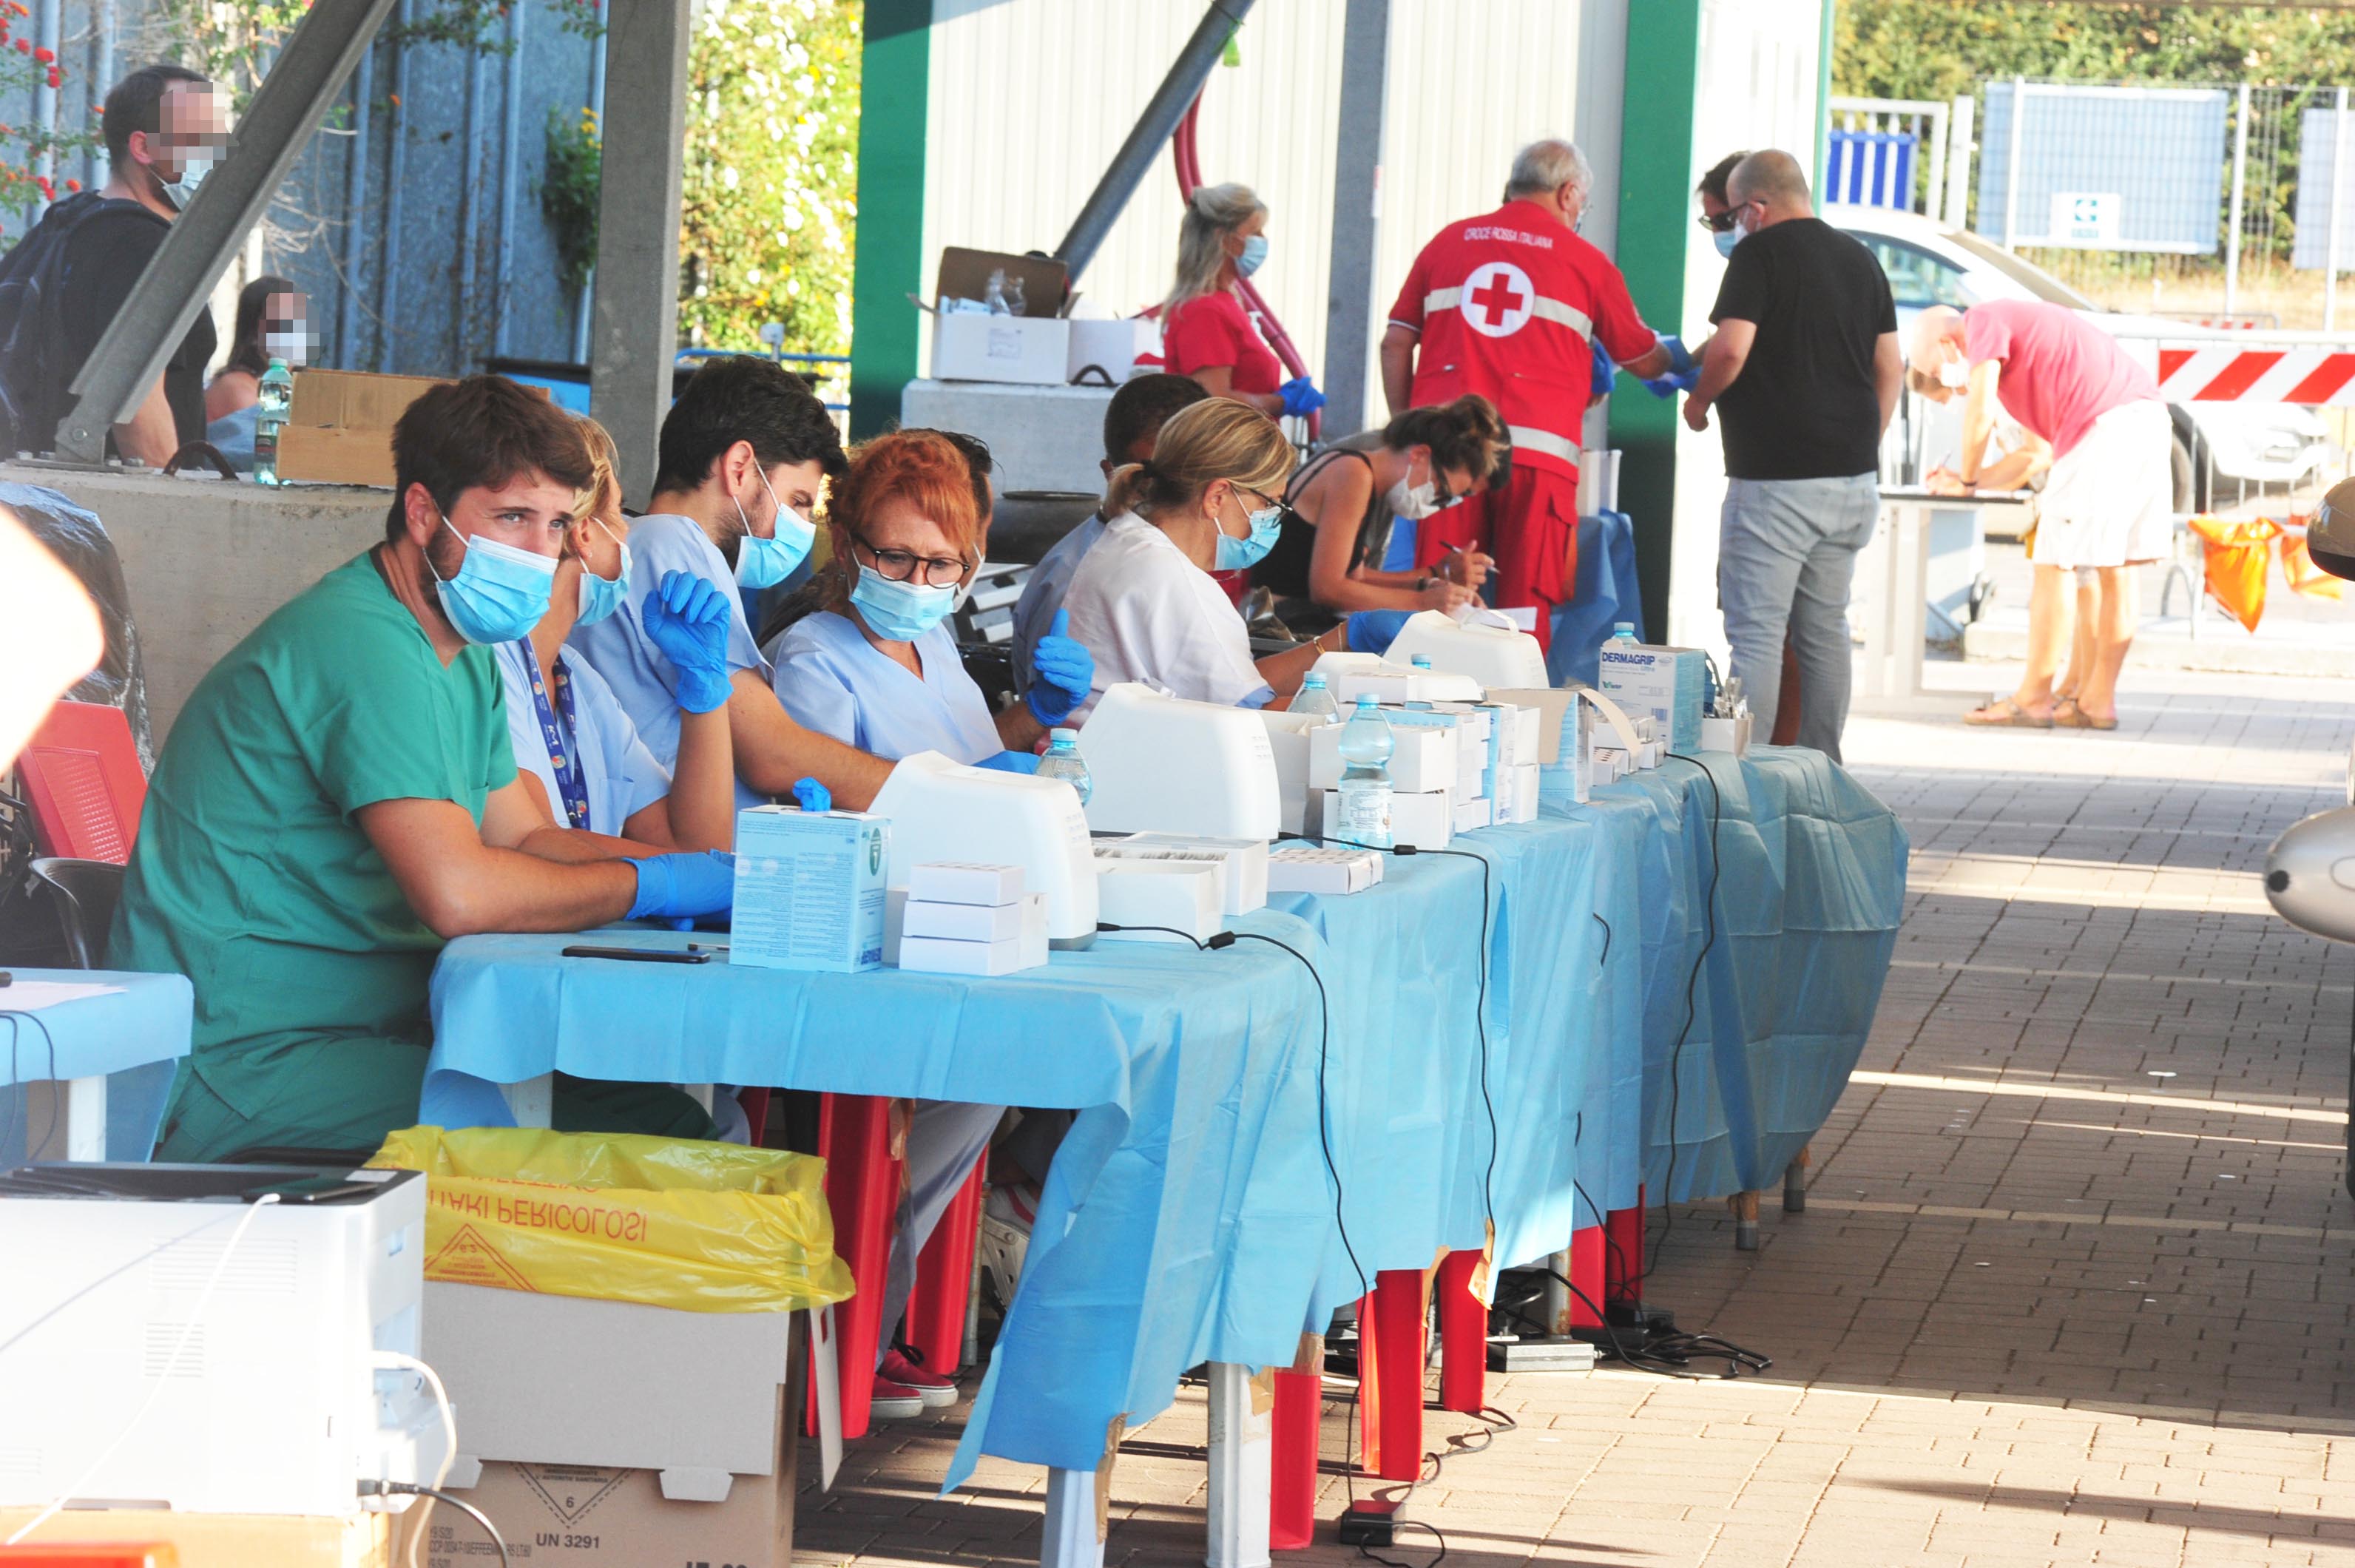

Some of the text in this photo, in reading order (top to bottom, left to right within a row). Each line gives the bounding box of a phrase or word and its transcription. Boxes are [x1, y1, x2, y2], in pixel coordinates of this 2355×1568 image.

[1464, 226, 1553, 249] CROCE ROSSA ITALIANA
[1601, 652, 1656, 666] DERMAGRIP
[566, 1496, 575, 1508] 6
[535, 1532, 600, 1549] UN 3291
